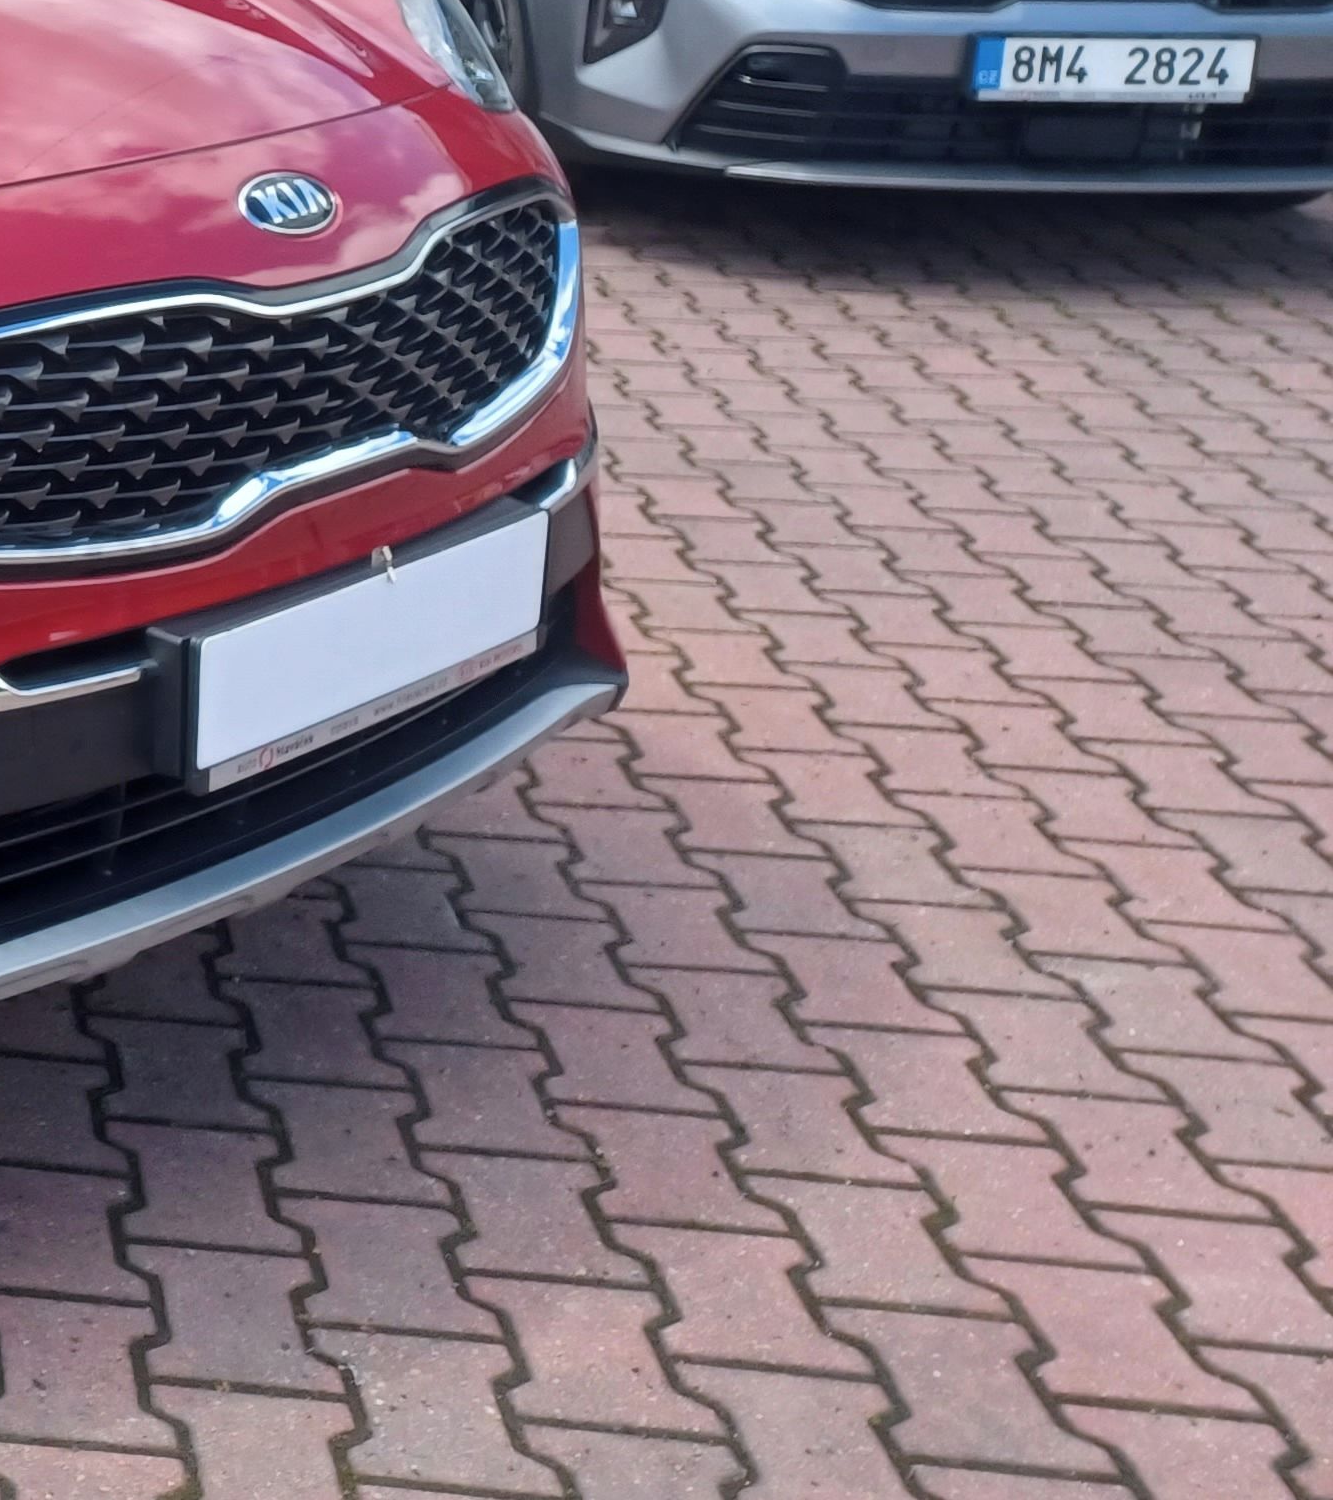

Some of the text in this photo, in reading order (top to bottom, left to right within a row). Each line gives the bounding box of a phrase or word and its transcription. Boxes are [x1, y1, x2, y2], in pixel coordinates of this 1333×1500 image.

[1011, 45, 1230, 86] 8M4 2824
[250, 178, 331, 225] KIA
